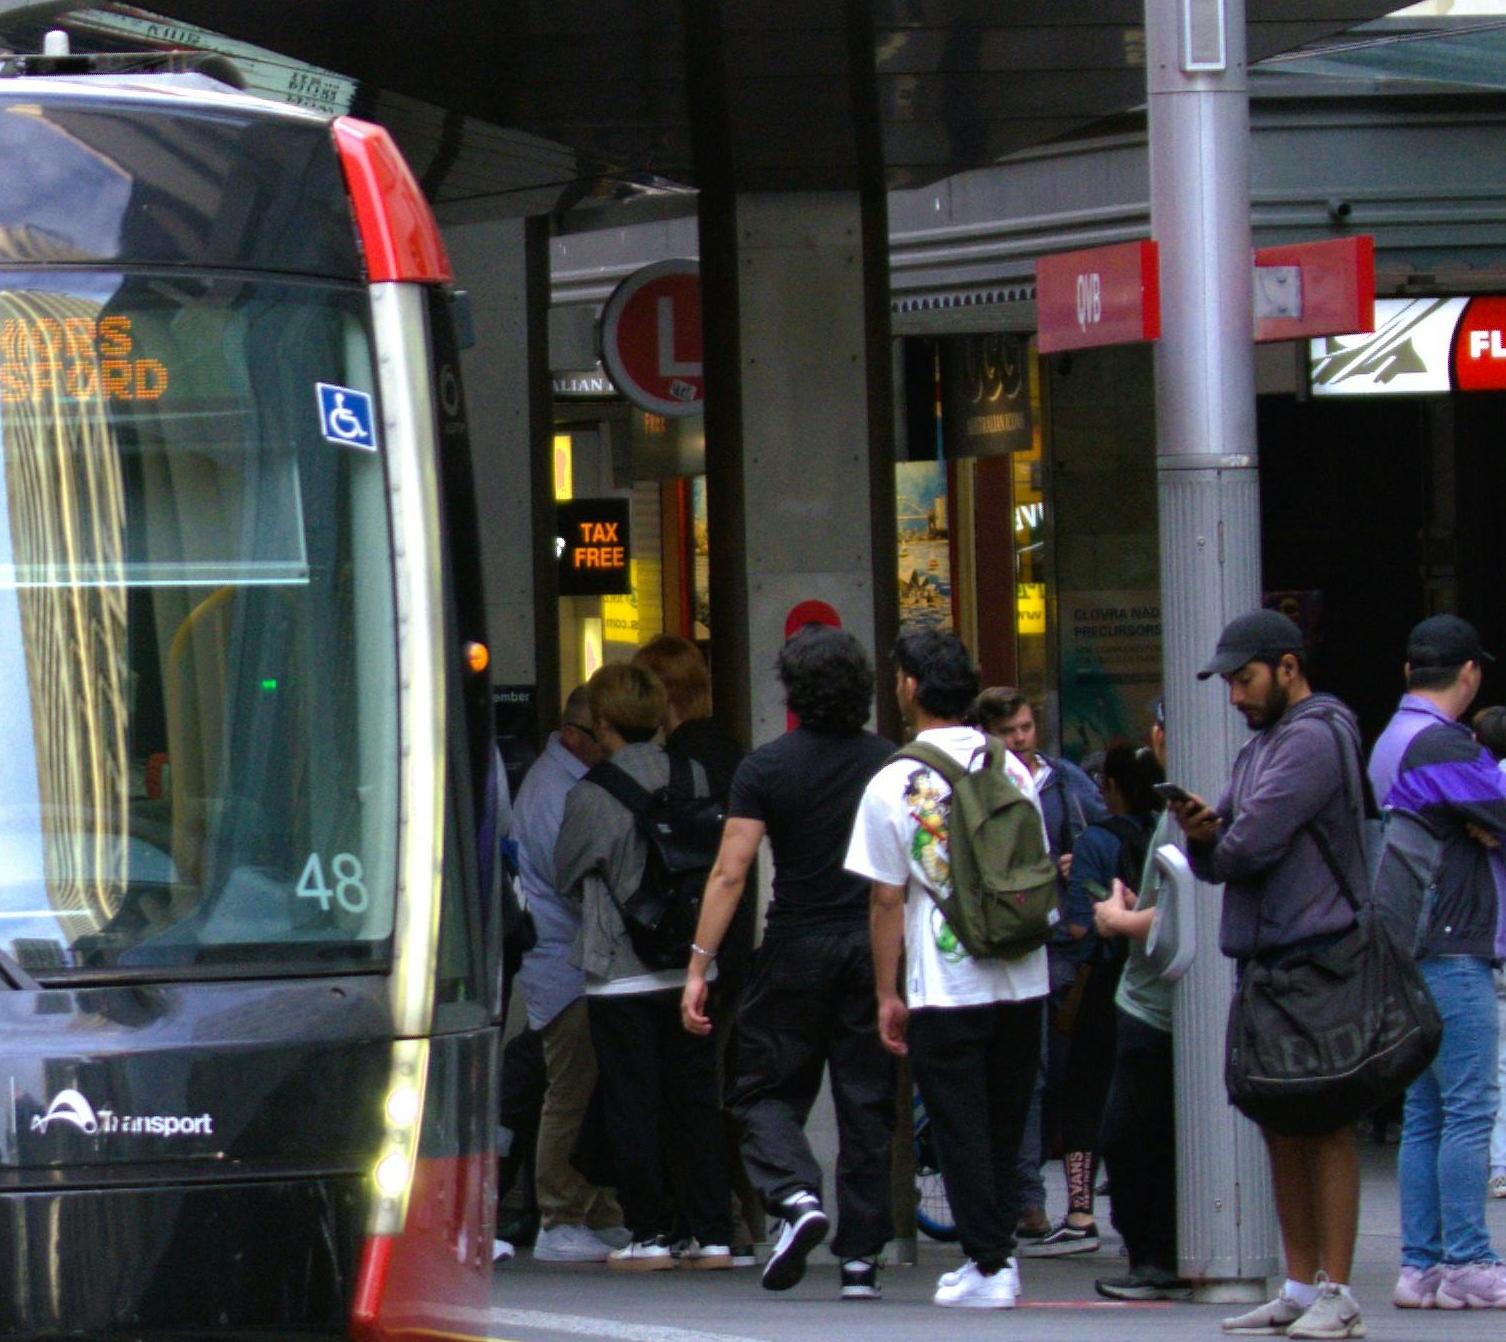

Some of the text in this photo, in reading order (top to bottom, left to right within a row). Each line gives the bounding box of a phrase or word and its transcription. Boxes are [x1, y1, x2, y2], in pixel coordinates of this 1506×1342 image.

[1077, 273, 1101, 334] QVB
[580, 522, 618, 543] TAX
[573, 547, 625, 569] FREE
[296, 852, 370, 914] 48
